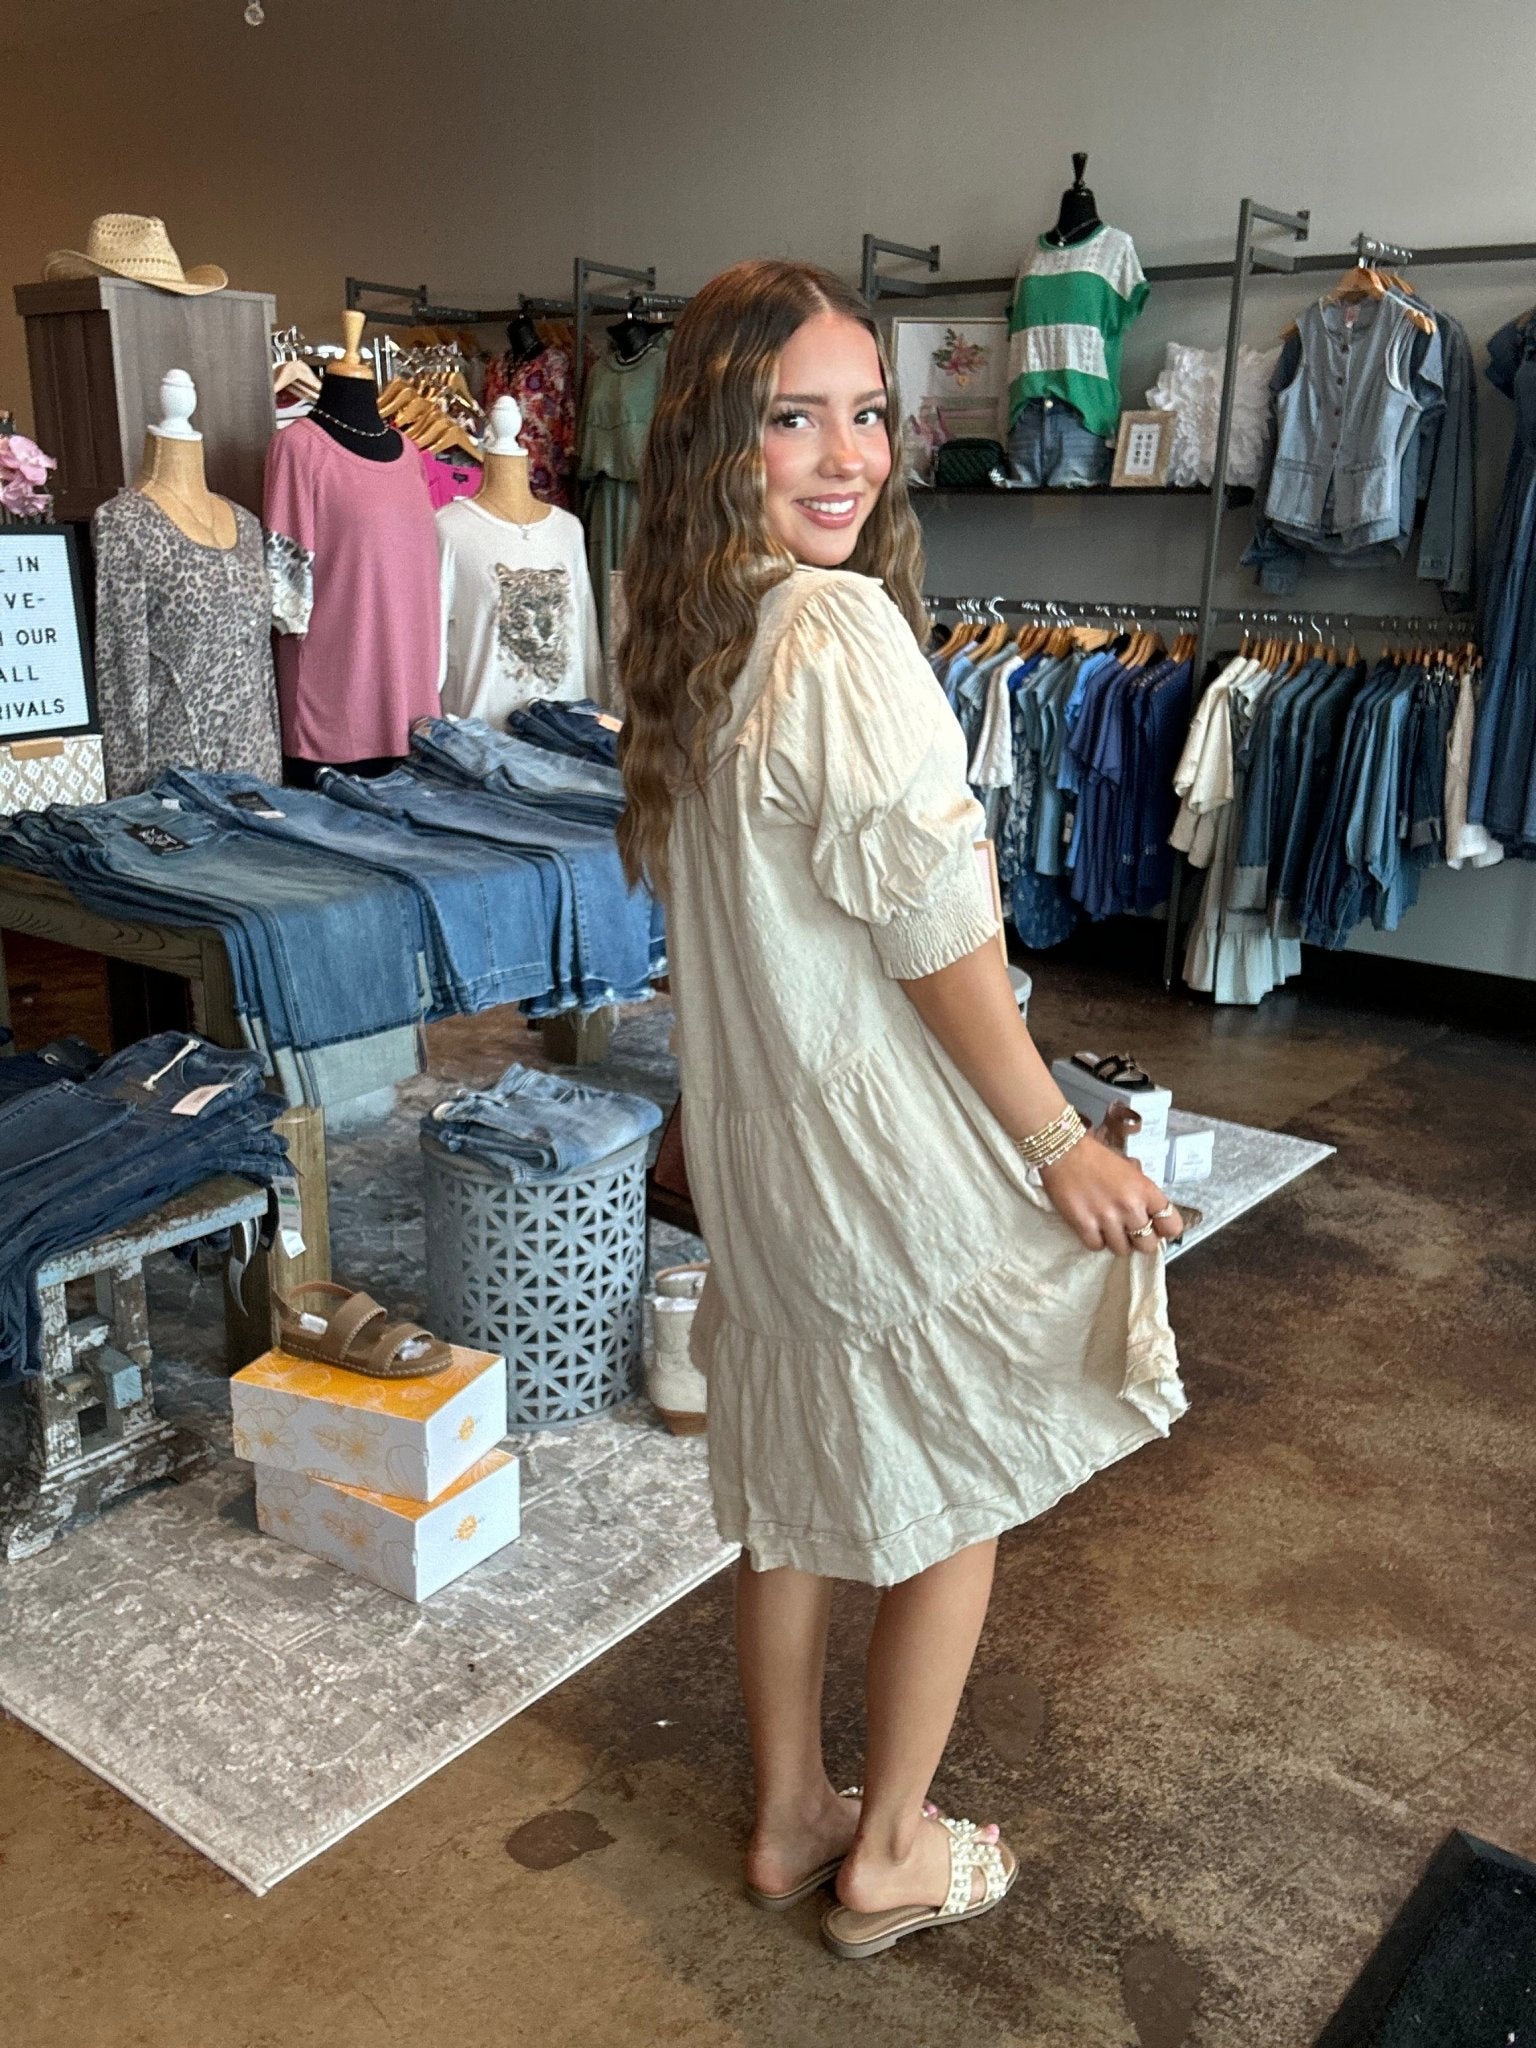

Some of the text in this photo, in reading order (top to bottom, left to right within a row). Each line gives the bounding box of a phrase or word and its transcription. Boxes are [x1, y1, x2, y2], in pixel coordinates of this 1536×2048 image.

[17, 556, 39, 572] IN
[16, 628, 57, 646] OUR
[0, 698, 65, 720] IVALS
